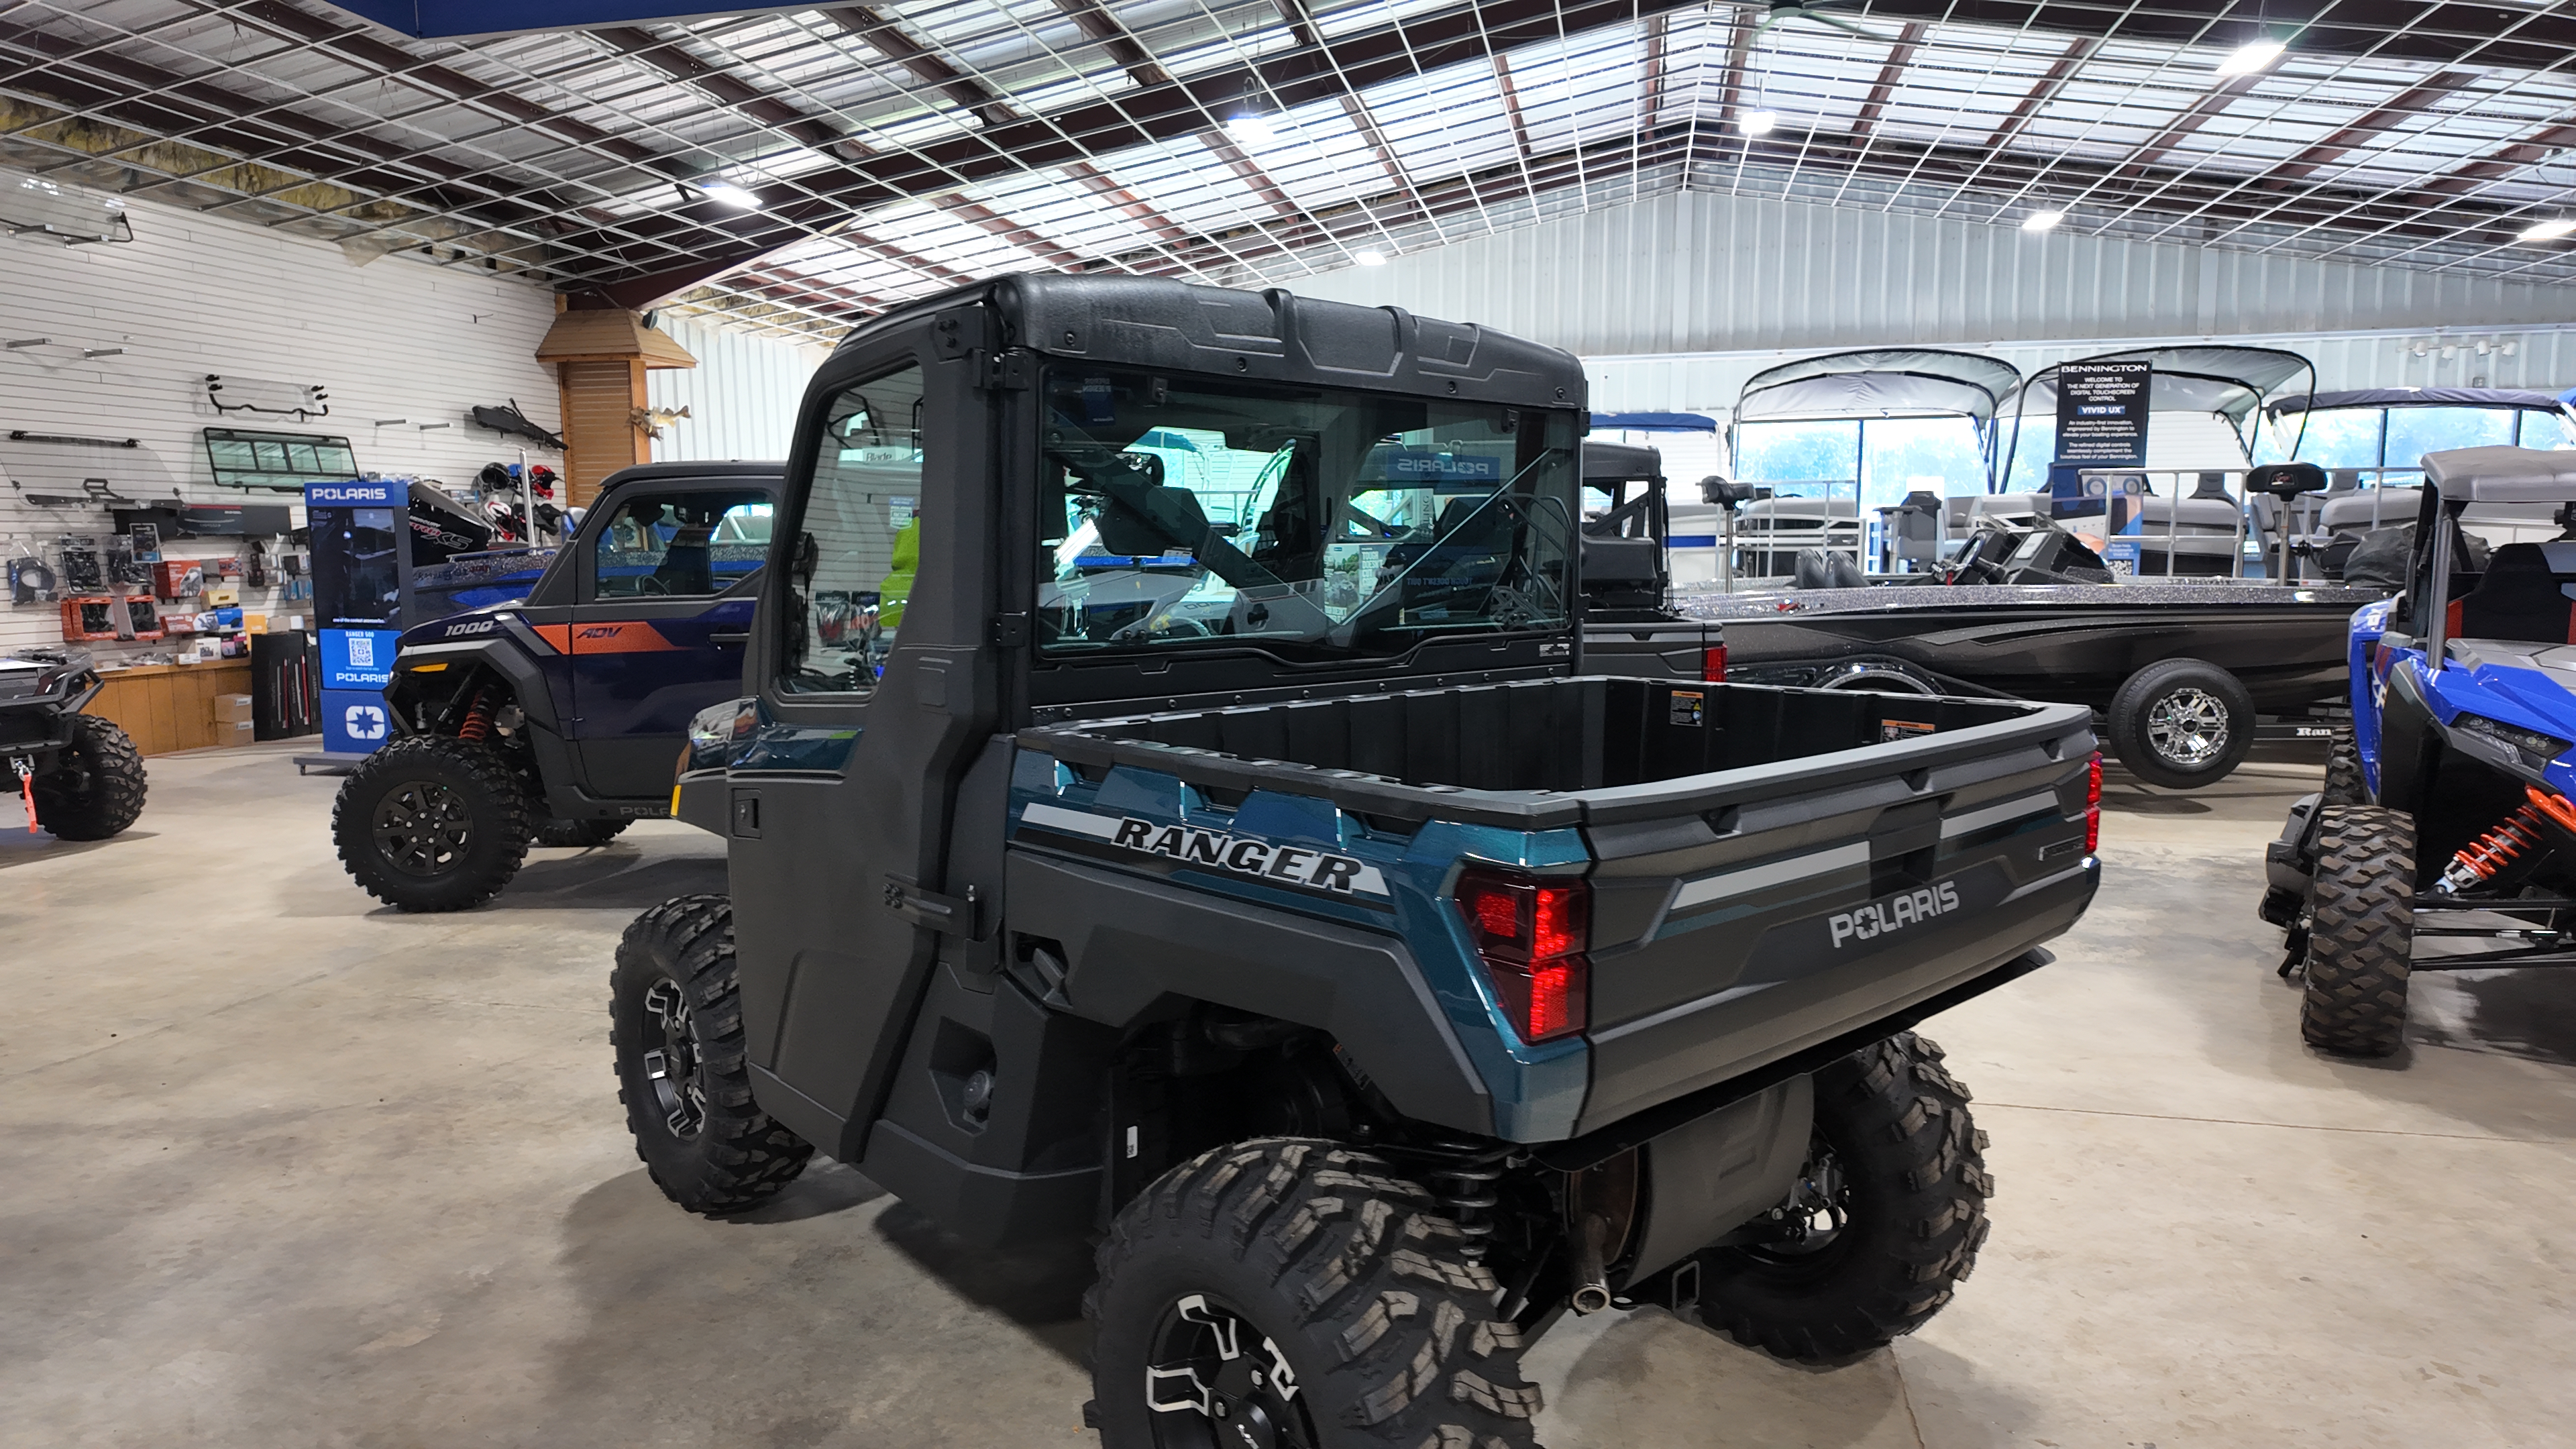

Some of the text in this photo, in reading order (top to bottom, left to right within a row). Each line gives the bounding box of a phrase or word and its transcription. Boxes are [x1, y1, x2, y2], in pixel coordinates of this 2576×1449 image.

[2061, 365, 2147, 373] BENNINGTON
[312, 488, 386, 500] POLARIS
[445, 621, 494, 637] 1000
[576, 626, 623, 639] ADV
[336, 672, 389, 683] POLARIS
[2296, 727, 2332, 737] Ran
[621, 806, 669, 817] POLA
[1110, 816, 1366, 894] RANGER
[1828, 880, 1960, 949] POLARIS
